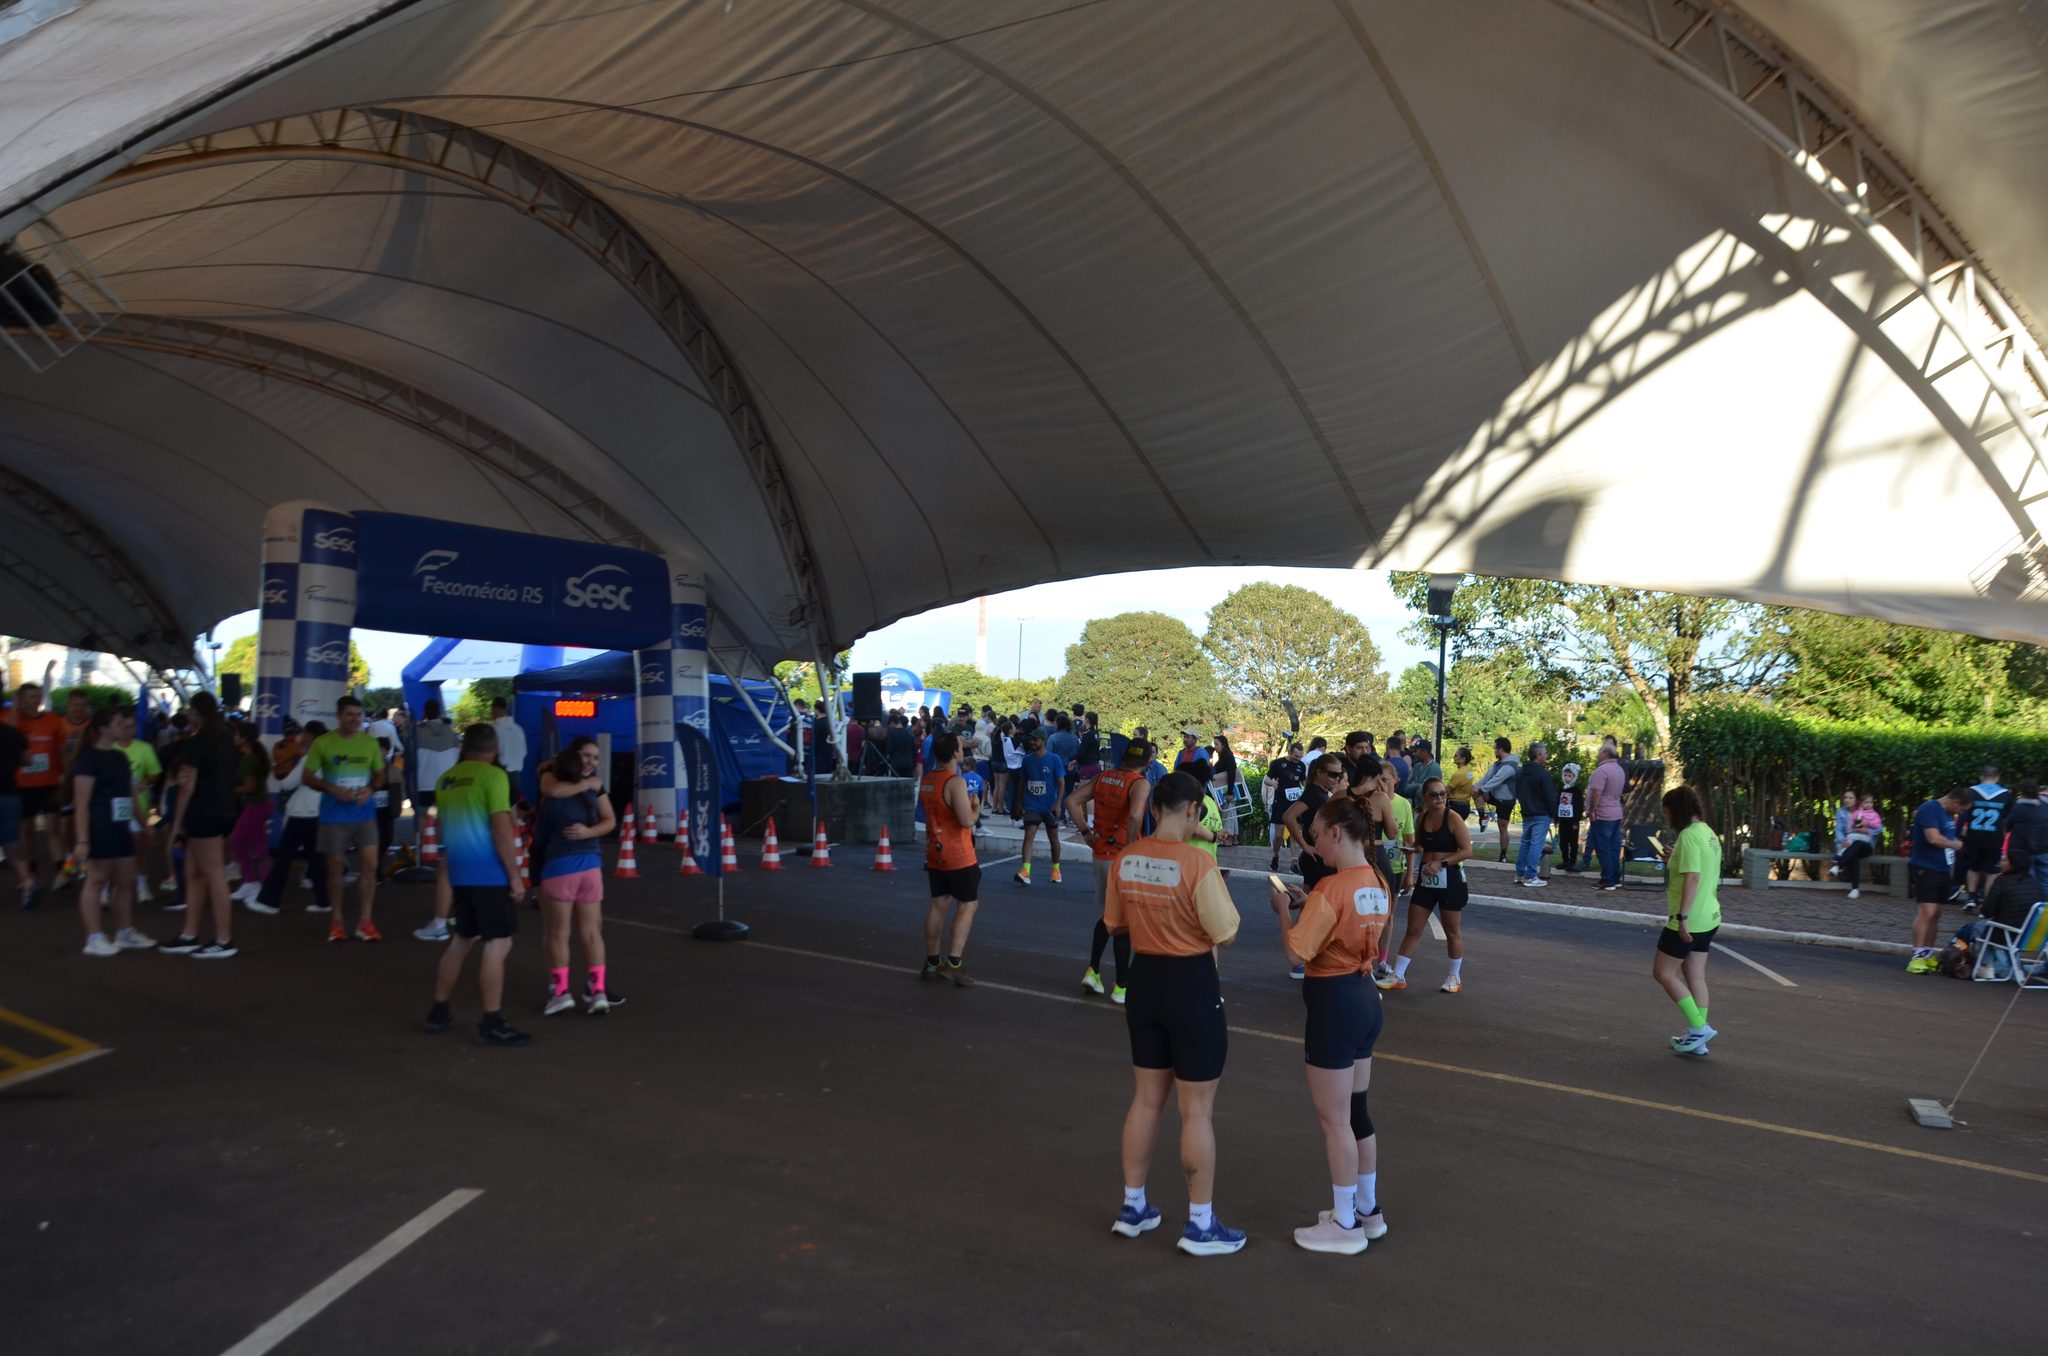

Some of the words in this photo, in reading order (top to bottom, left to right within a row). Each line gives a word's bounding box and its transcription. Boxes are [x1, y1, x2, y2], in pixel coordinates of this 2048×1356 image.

[421, 574, 518, 602] Fecomércio
[521, 586, 544, 604] RS
[563, 566, 633, 612] Sesc
[680, 621, 706, 638] Ses
[1030, 786, 1044, 795] 507
[694, 800, 711, 858] Sesc
[1970, 808, 2000, 832] 22
